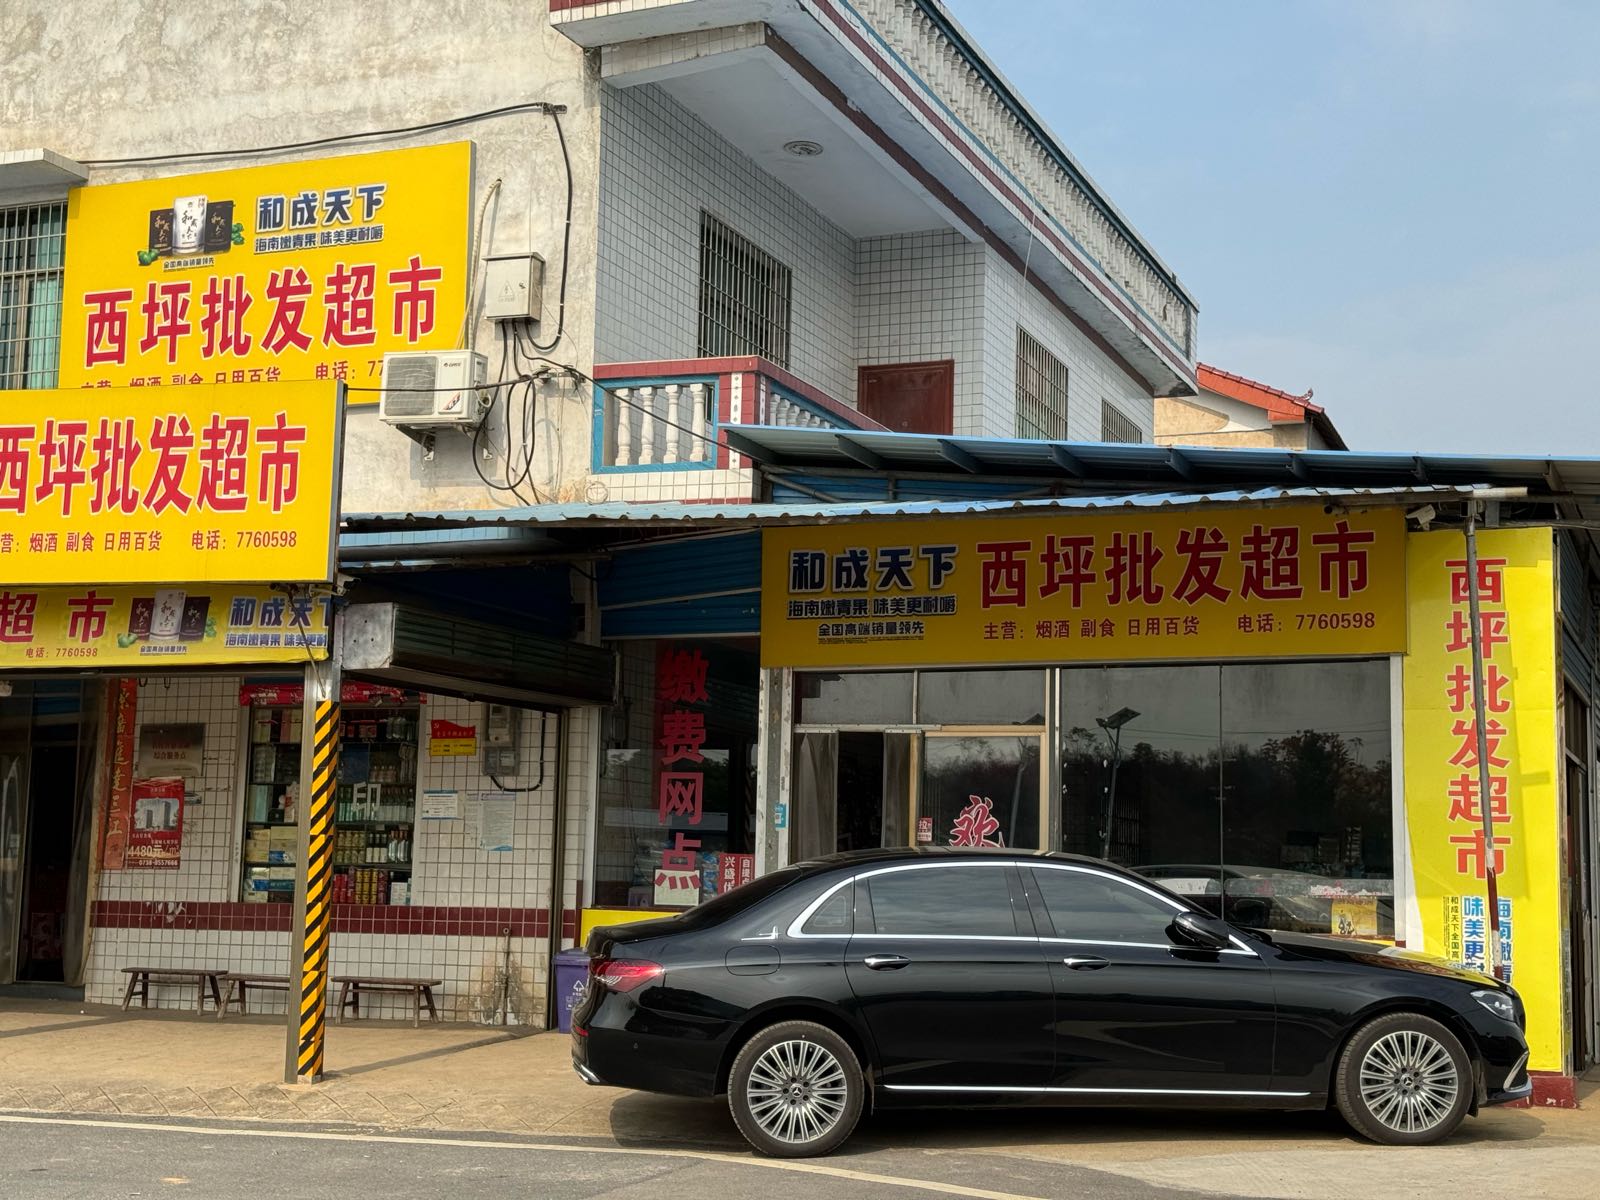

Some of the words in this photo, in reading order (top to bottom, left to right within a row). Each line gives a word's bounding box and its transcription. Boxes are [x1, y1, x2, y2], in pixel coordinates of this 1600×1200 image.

[256, 184, 386, 232] 和成天下
[84, 257, 442, 368] 西坪批发超市
[0, 411, 306, 518] 西坪批发超市
[29, 532, 58, 553] 烟酒
[66, 532, 95, 552] 副食
[104, 530, 162, 551] 日用百货
[237, 530, 297, 548] 7760598
[790, 547, 957, 592] 和成天下
[978, 521, 1376, 608] 西坪批发超市
[788, 600, 869, 617] 海南嫩青果
[1035, 619, 1070, 638] 烟酒
[1080, 618, 1116, 637] 副食
[1128, 616, 1199, 636] 日用百货
[1296, 612, 1375, 630] 7760598
[56, 647, 98, 657] 7760598
[1446, 558, 1511, 879] 西坪批发超市
[655, 648, 709, 890] 缴费网点
